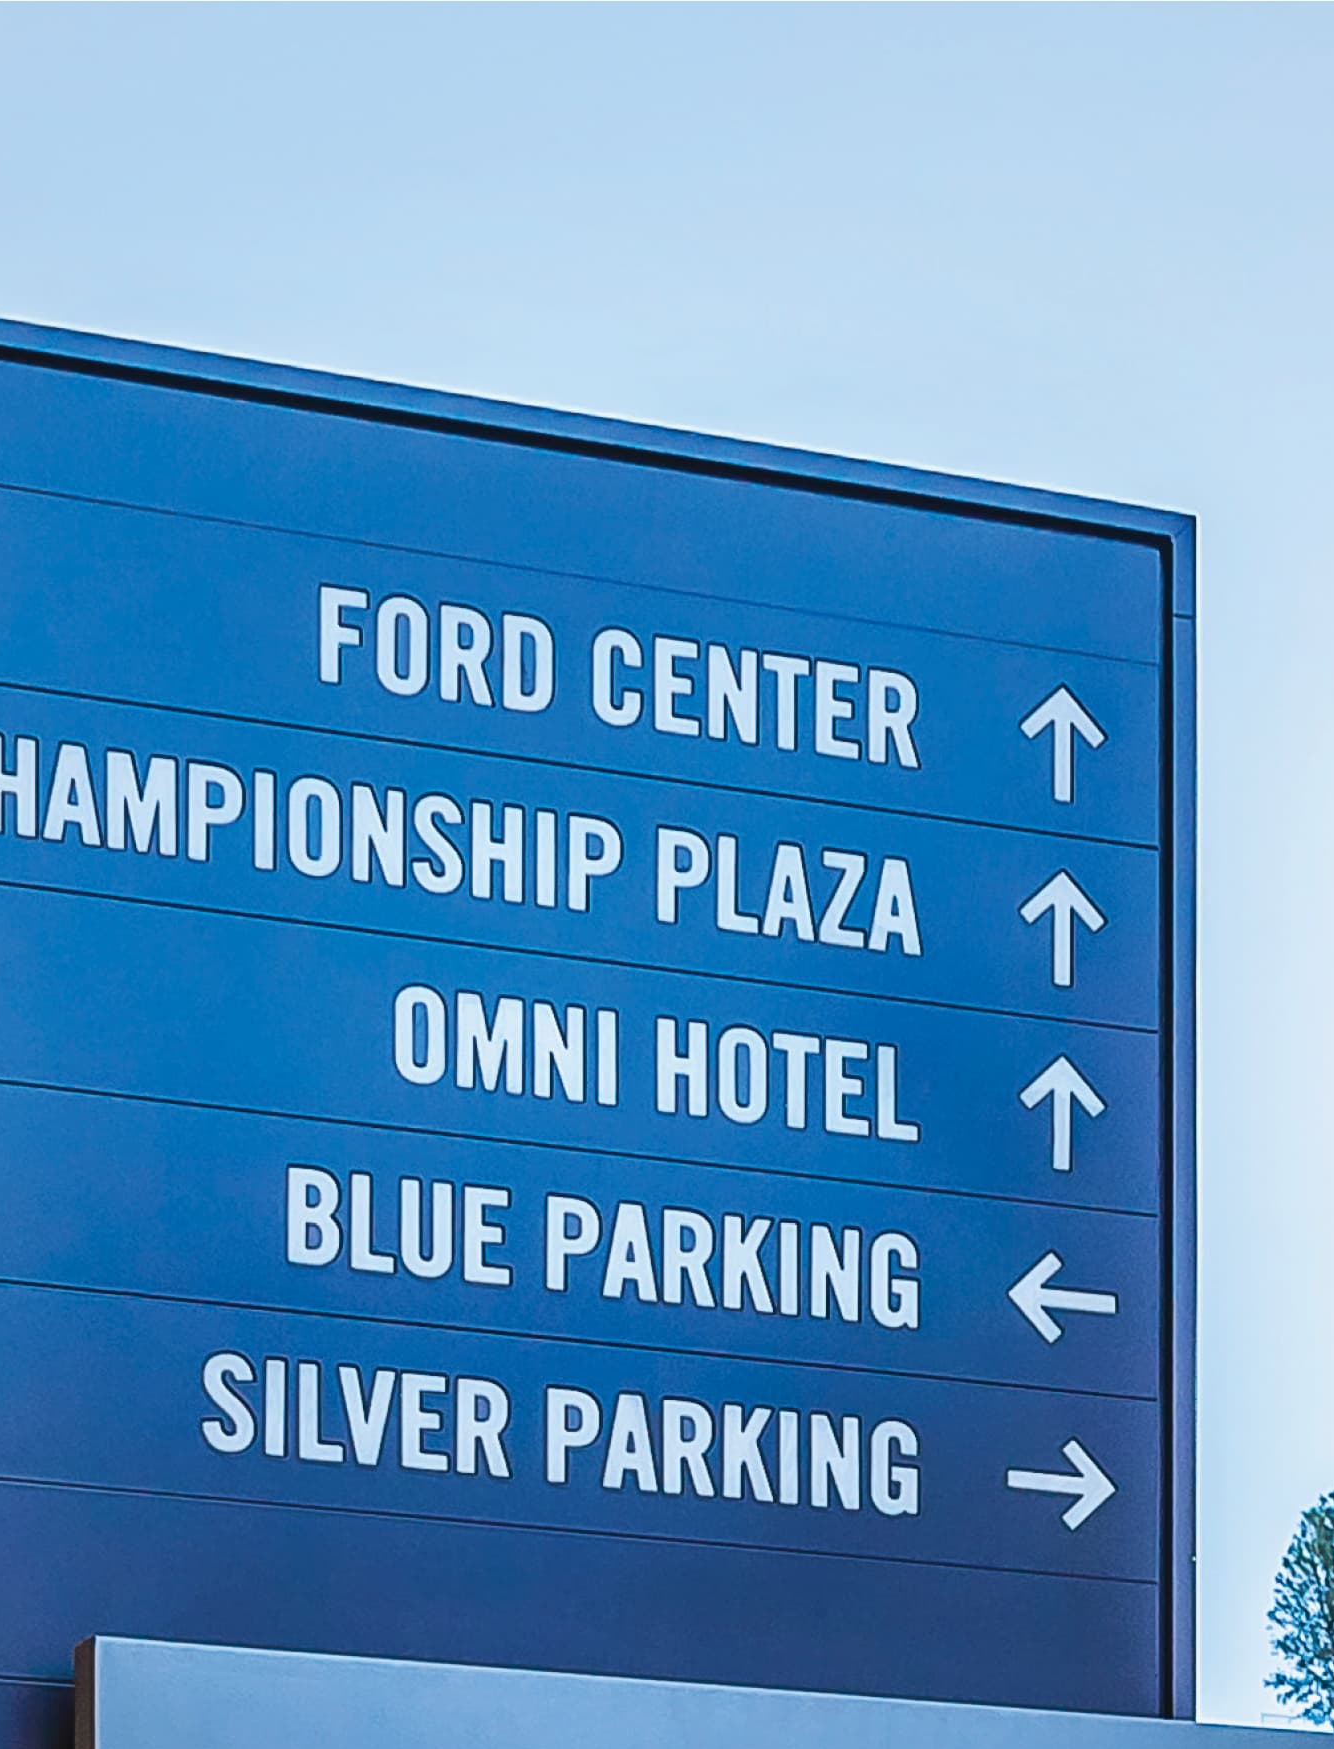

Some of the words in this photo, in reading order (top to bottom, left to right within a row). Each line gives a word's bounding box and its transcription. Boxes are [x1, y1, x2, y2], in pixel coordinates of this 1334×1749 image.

[317, 582, 555, 714] FORD
[591, 626, 922, 770] CENTER
[657, 826, 924, 957] PLAZA
[393, 984, 617, 1106] OMNI
[654, 1015, 921, 1142] HOTEL
[286, 1164, 512, 1286] BLUE
[544, 1193, 922, 1331] PARKING
[201, 1352, 511, 1480] SILVER
[545, 1387, 922, 1518] PARKING
